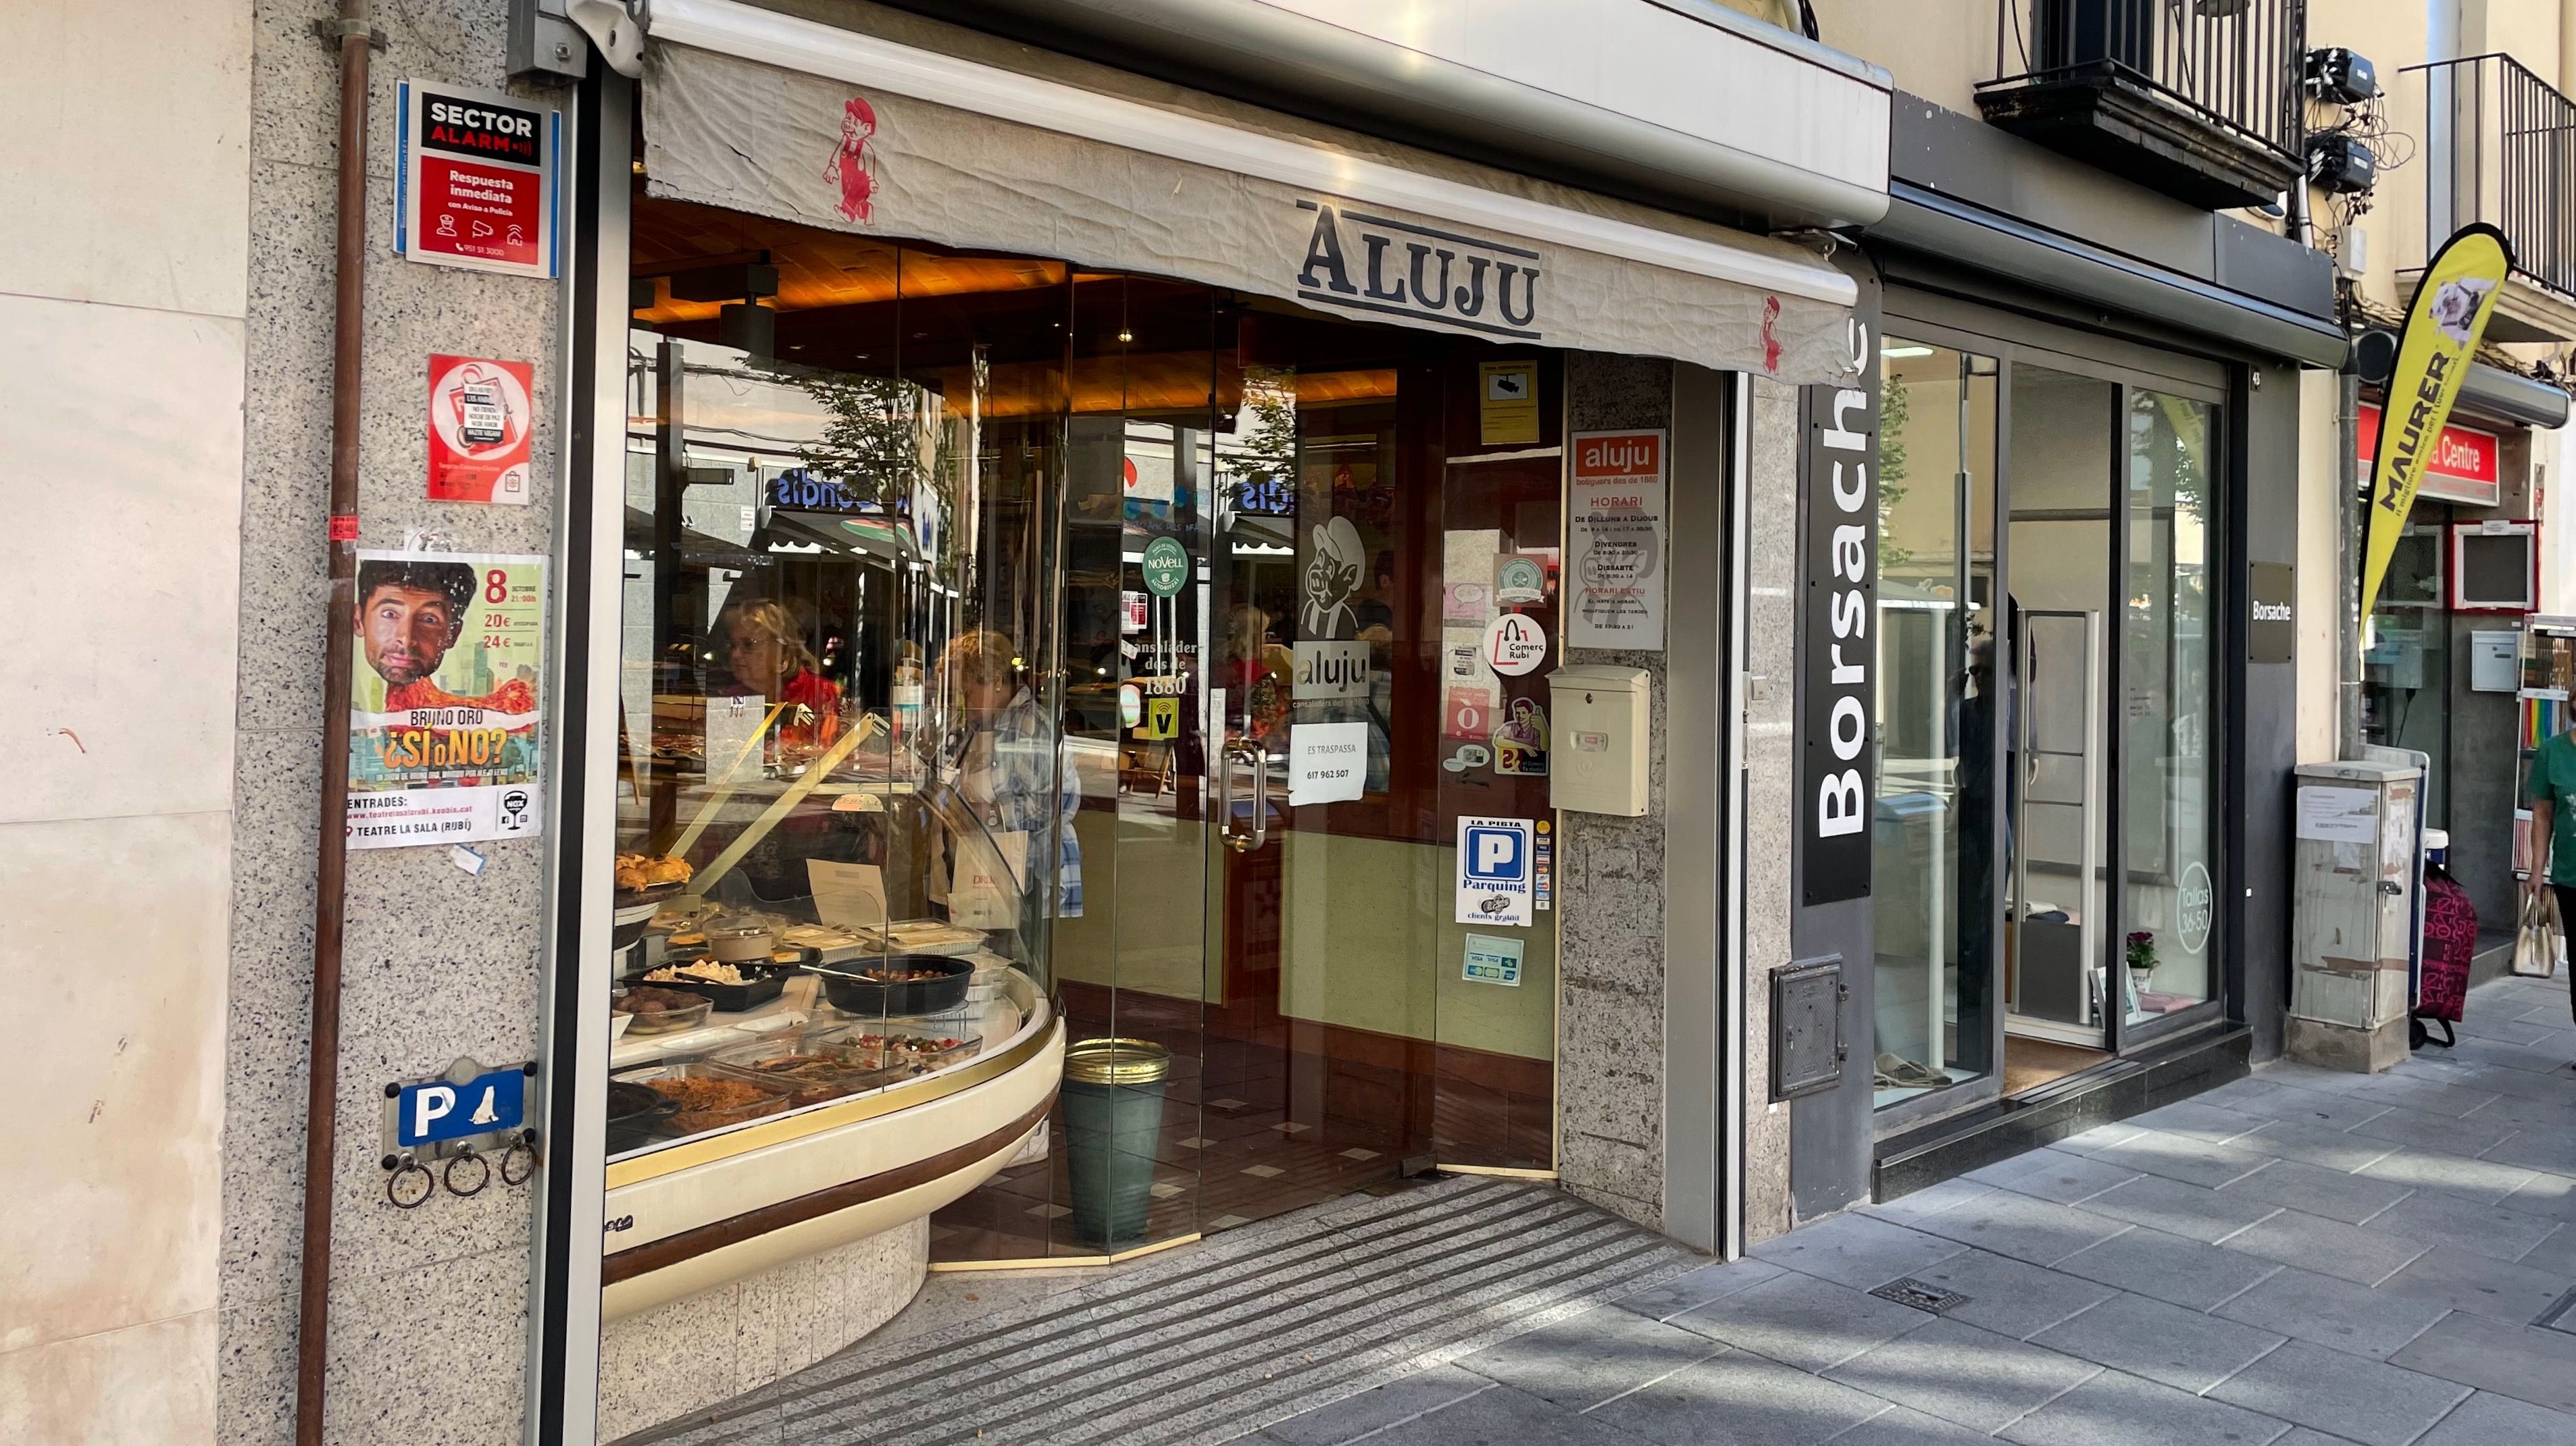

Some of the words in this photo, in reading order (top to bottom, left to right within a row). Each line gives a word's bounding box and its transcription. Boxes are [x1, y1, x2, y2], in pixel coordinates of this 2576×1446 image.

[431, 103, 532, 138] SECTOR
[431, 126, 509, 152] ALARM
[450, 170, 513, 190] Respuesta
[450, 184, 512, 204] inmediata
[463, 203, 482, 212] Aviso
[1297, 205, 1540, 326] ALUJU
[2379, 352, 2450, 512] MAURER
[1586, 440, 1649, 473] aluju
[2442, 435, 2480, 473] Centre
[1613, 476, 1626, 484] des
[1591, 496, 1642, 507] HORARI
[485, 569, 507, 603] 8
[2253, 600, 2290, 621] Borsache
[1509, 643, 1544, 652] Comerç
[1296, 650, 1366, 693] aluju
[1144, 677, 1186, 694] 1880
[411, 711, 453, 726] BRUNO
[458, 709, 483, 723] ORO
[1156, 713, 1172, 734] V
[1308, 746, 1316, 755] ES
[1317, 744, 1356, 754] TRASPASSA
[1307, 771, 1318, 779] 617
[1320, 770, 1334, 779] 962
[1336, 769, 1348, 778] 507
[347, 796, 407, 809] ENTRADES:
[507, 800, 524, 808] NOX
[357, 825, 397, 836] TEATRE
[400, 824, 411, 834] LA
[414, 822, 437, 833] SALA
[441, 818, 472, 833] (RUBÍ)
[1478, 833, 1514, 873] P
[1463, 879, 1526, 894] Parquing
[2182, 886, 2208, 908] Tallas
[1467, 912, 1492, 920] clients
[2181, 909, 2208, 933] 36-50
[415, 1086, 456, 1137] P
